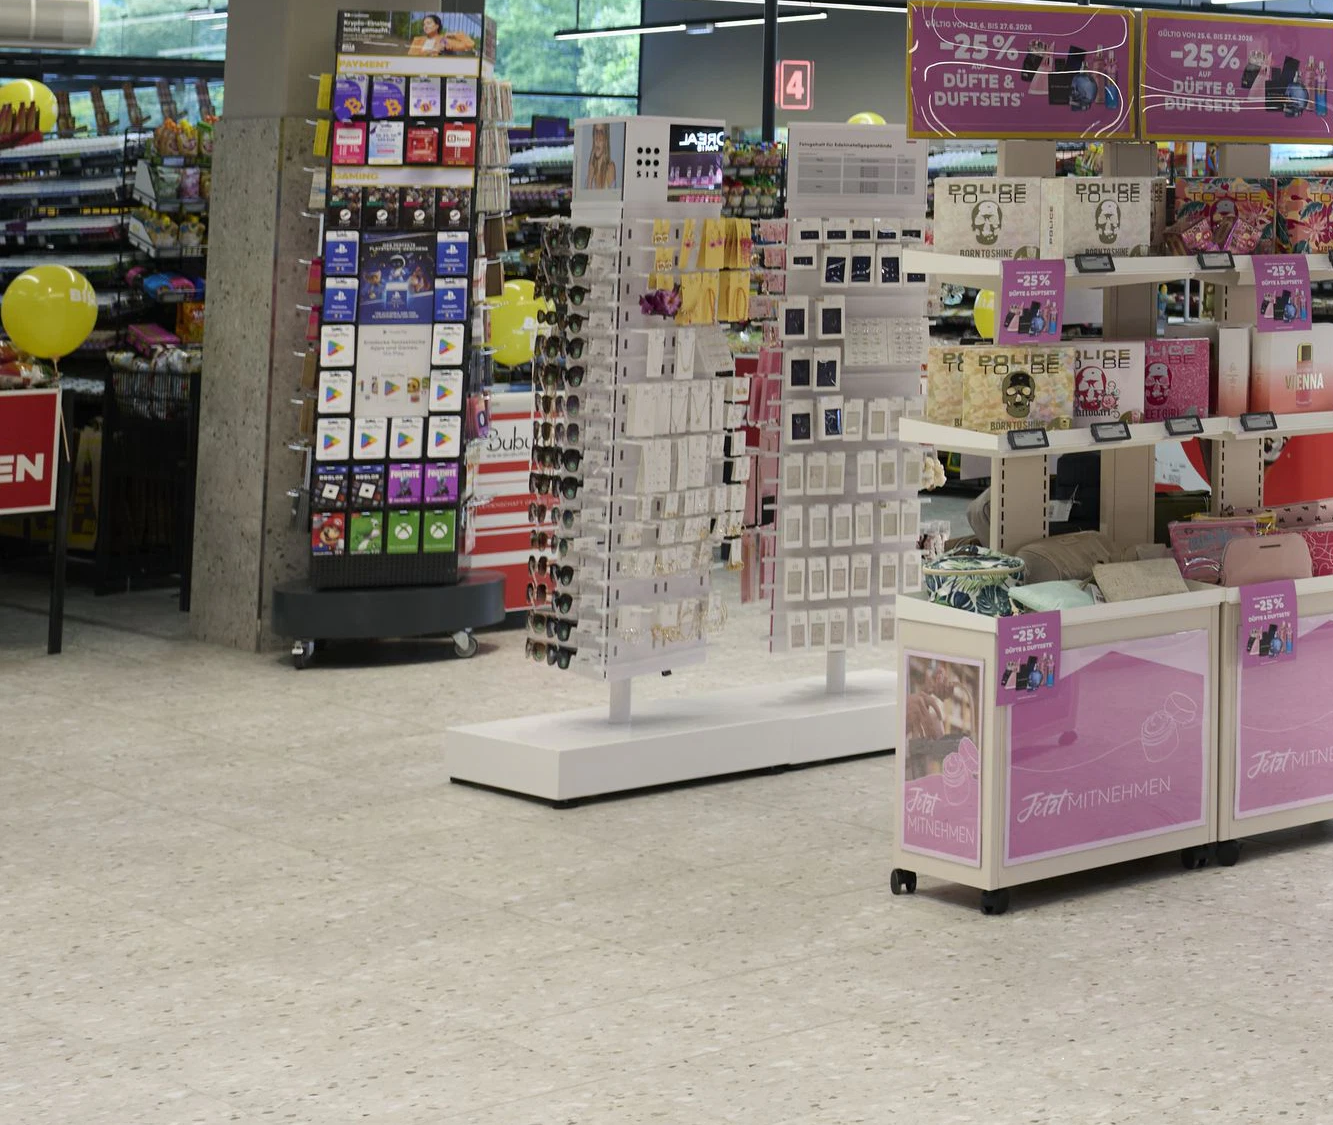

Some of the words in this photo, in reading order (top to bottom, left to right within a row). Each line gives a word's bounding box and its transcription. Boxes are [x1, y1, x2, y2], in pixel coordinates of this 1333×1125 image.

[786, 70, 805, 100] 4
[943, 69, 1000, 88] DÜFTE
[1003, 75, 1015, 89] &
[1173, 76, 1222, 95] DÜFTE
[1225, 82, 1236, 95] &
[949, 183, 1027, 194] POLICE
[1076, 183, 1140, 194] POLICE
[950, 193, 977, 203] TO
[999, 193, 1026, 203] BE
[1079, 193, 1100, 203] TO
[1118, 193, 1140, 203] BE
[1188, 192, 1215, 202] TO
[1235, 192, 1262, 202] BE
[1311, 192, 1328, 202] TO
[1147, 344, 1196, 356] LICE
[979, 353, 1060, 366] POLICE
[1103, 358, 1131, 369] BE
[1169, 355, 1197, 365] BE
[982, 364, 1009, 375] TO
[1031, 363, 1060, 375] BE
[1285, 372, 1325, 391] VIENNA
[1247, 748, 1298, 779] Jetzt
[907, 787, 941, 817] Jetzt
[1017, 789, 1074, 823] Jetzt
[1069, 776, 1171, 811] MITNEHMEN
[907, 816, 975, 845] MITNEHMEN
